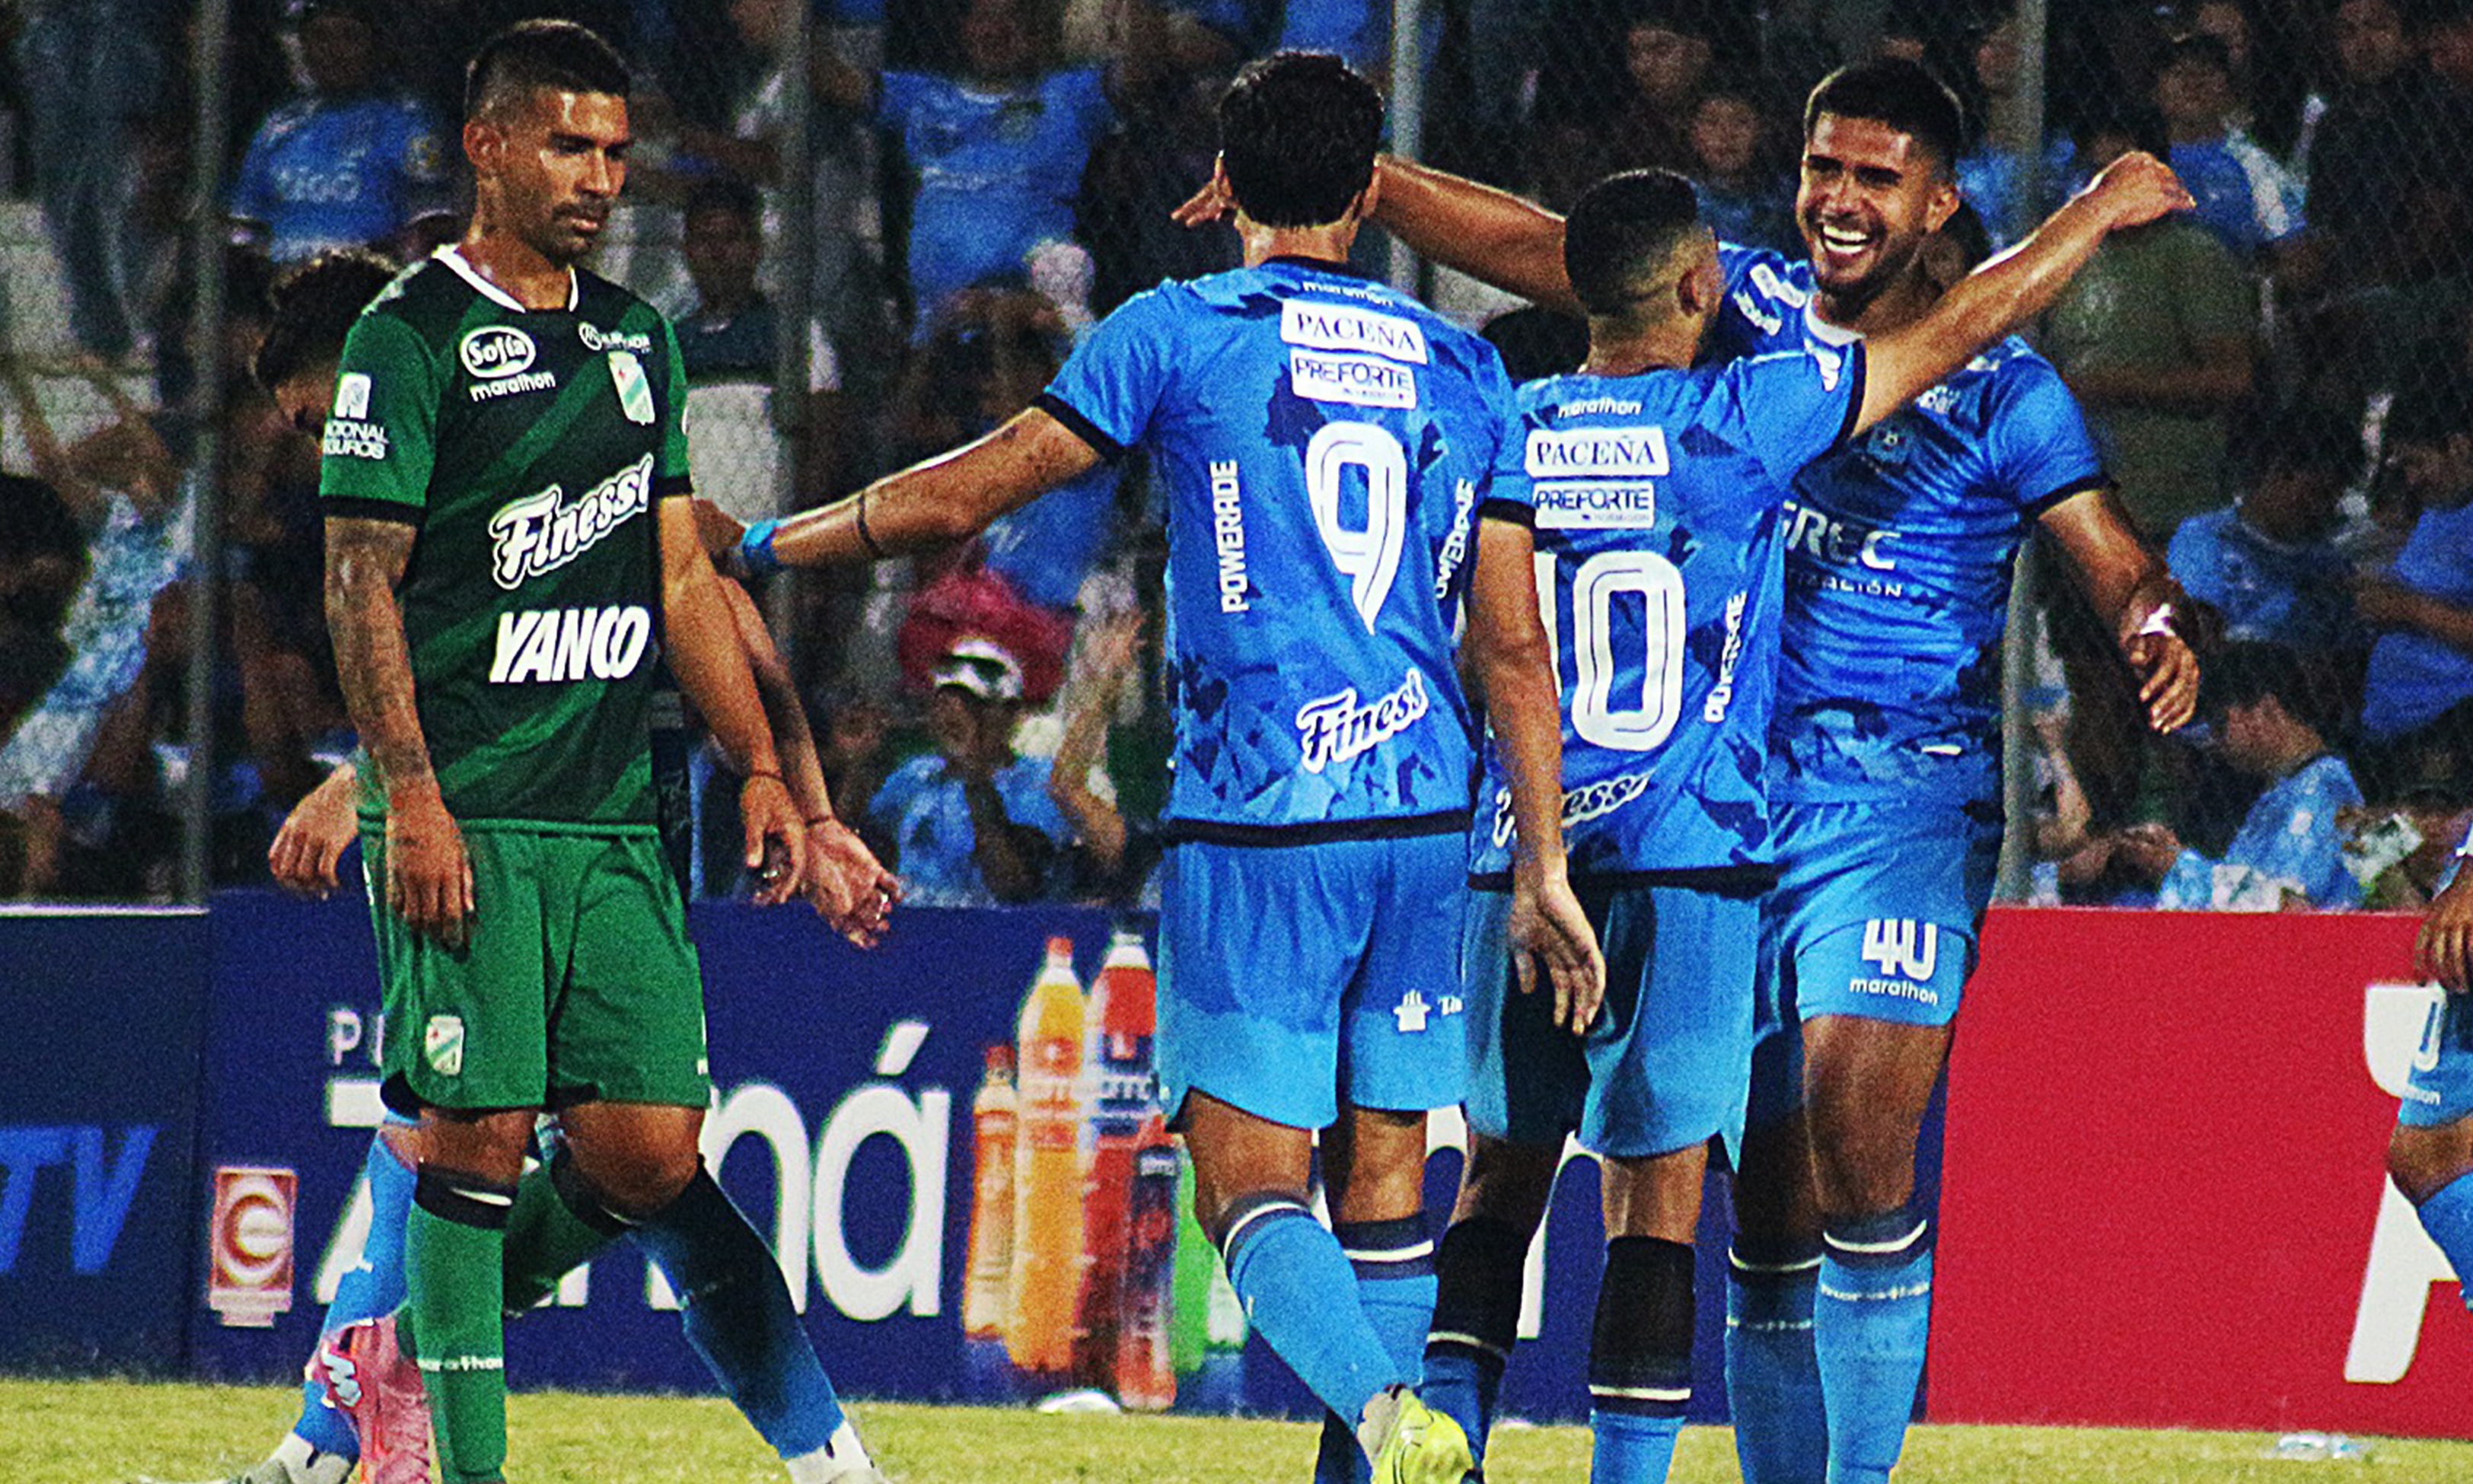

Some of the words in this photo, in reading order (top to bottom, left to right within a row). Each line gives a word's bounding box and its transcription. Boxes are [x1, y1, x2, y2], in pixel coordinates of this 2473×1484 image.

[1297, 311, 1417, 351] PACEÑA
[470, 371, 556, 402] marathon
[1295, 358, 1411, 390] PREFORTE
[1536, 435, 1656, 466] PACEÑA
[1534, 487, 1650, 510] PREFORTE
[1209, 459, 1250, 613] POWERADE
[1305, 421, 1407, 633] 9
[1435, 478, 1475, 600] OWERADE
[489, 606, 651, 683] YANCO
[1850, 979, 1939, 1006] marathon
